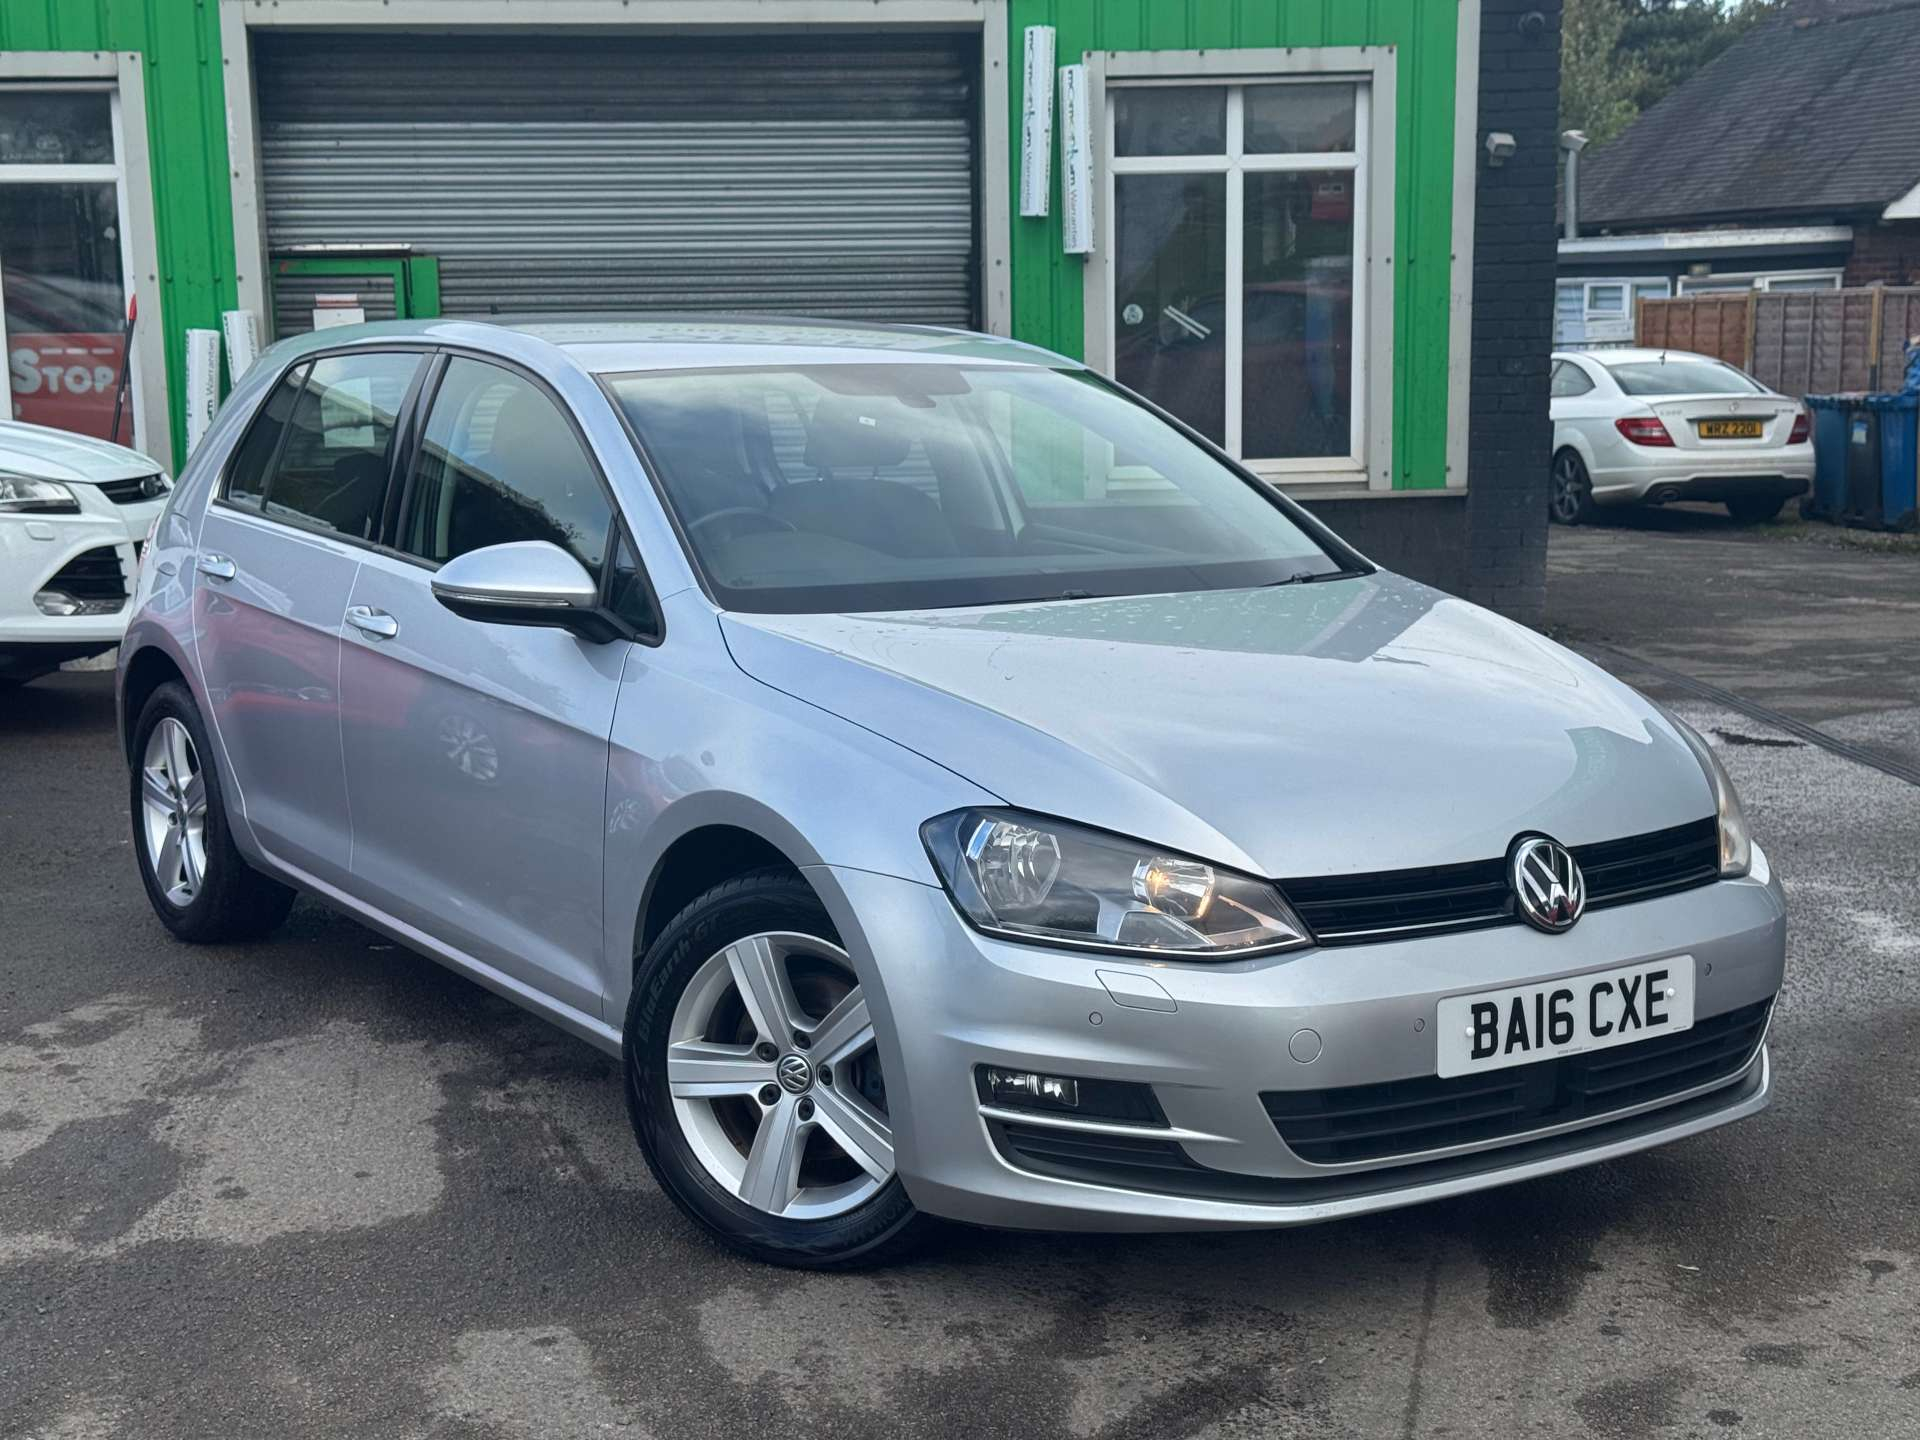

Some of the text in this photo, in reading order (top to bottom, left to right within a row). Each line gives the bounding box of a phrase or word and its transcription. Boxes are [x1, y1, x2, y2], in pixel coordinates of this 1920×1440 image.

[1070, 189, 1080, 249] Warranties
[205, 337, 216, 396] Warranties
[1471, 970, 1669, 1060] BA16 CXE
